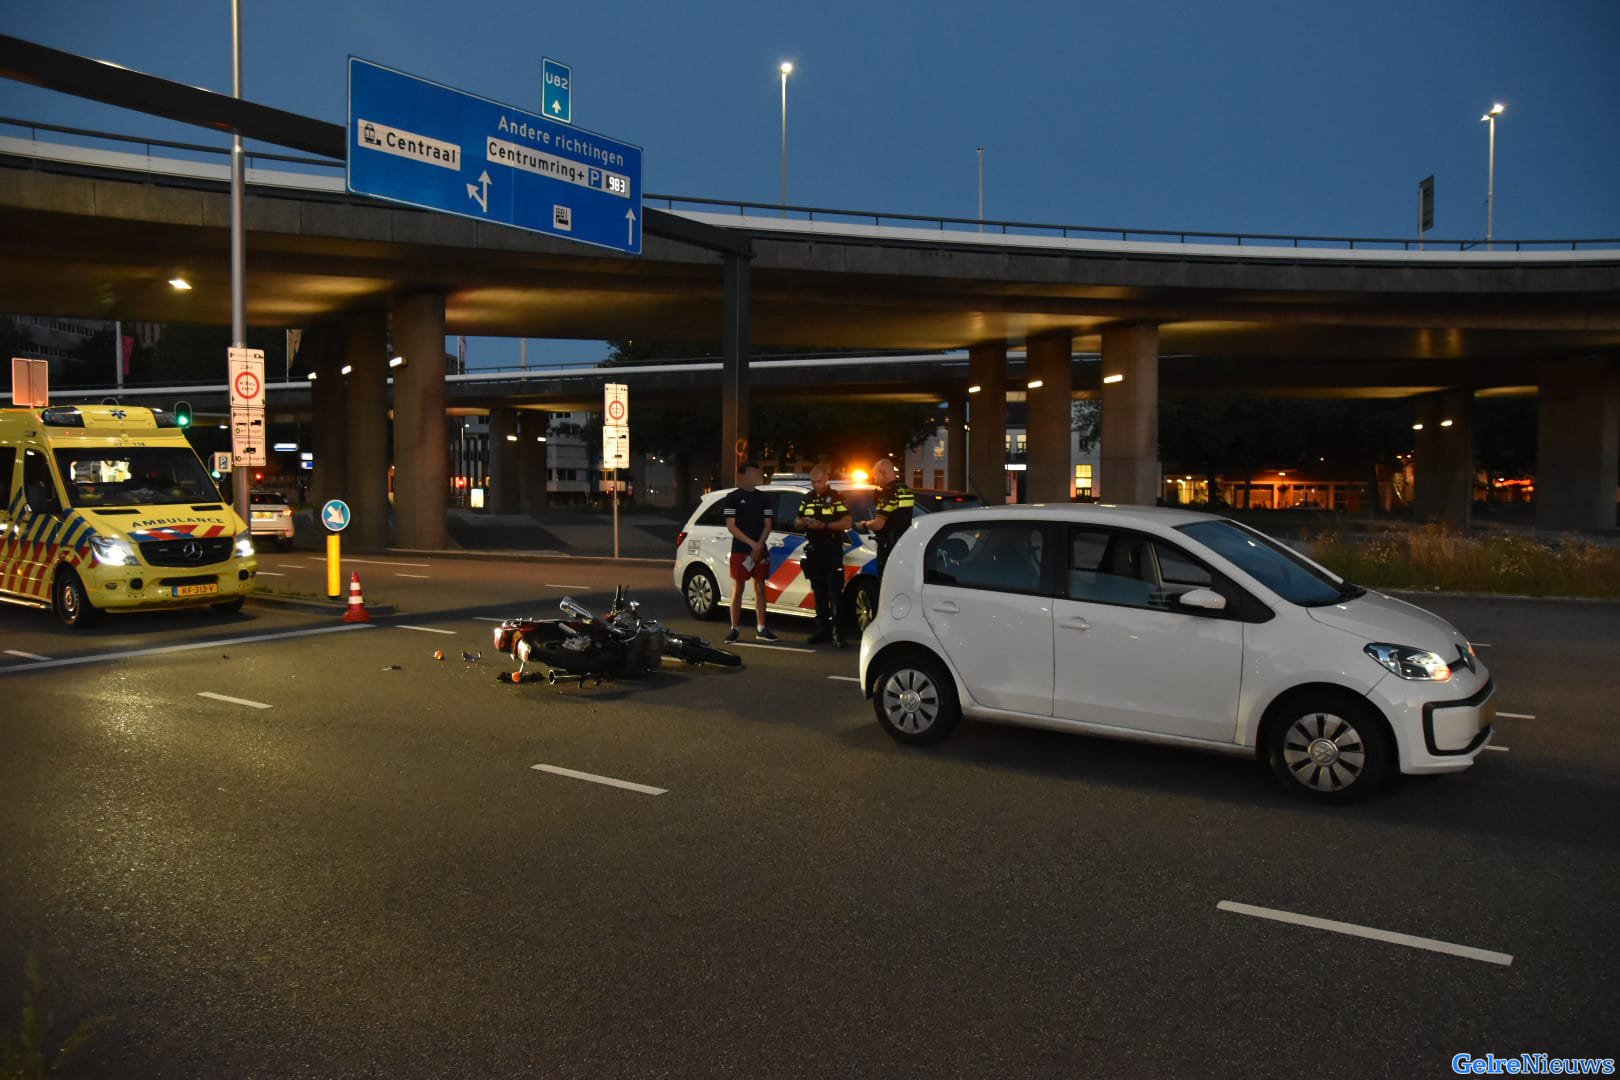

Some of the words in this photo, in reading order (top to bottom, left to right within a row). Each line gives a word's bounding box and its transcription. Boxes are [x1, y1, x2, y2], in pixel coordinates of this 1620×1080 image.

[545, 71, 569, 90] U82
[386, 132, 456, 164] Centraal
[498, 115, 550, 144] Andere
[555, 135, 624, 167] richtingen
[608, 176, 626, 194] 983
[132, 517, 225, 528] AMBULANCE
